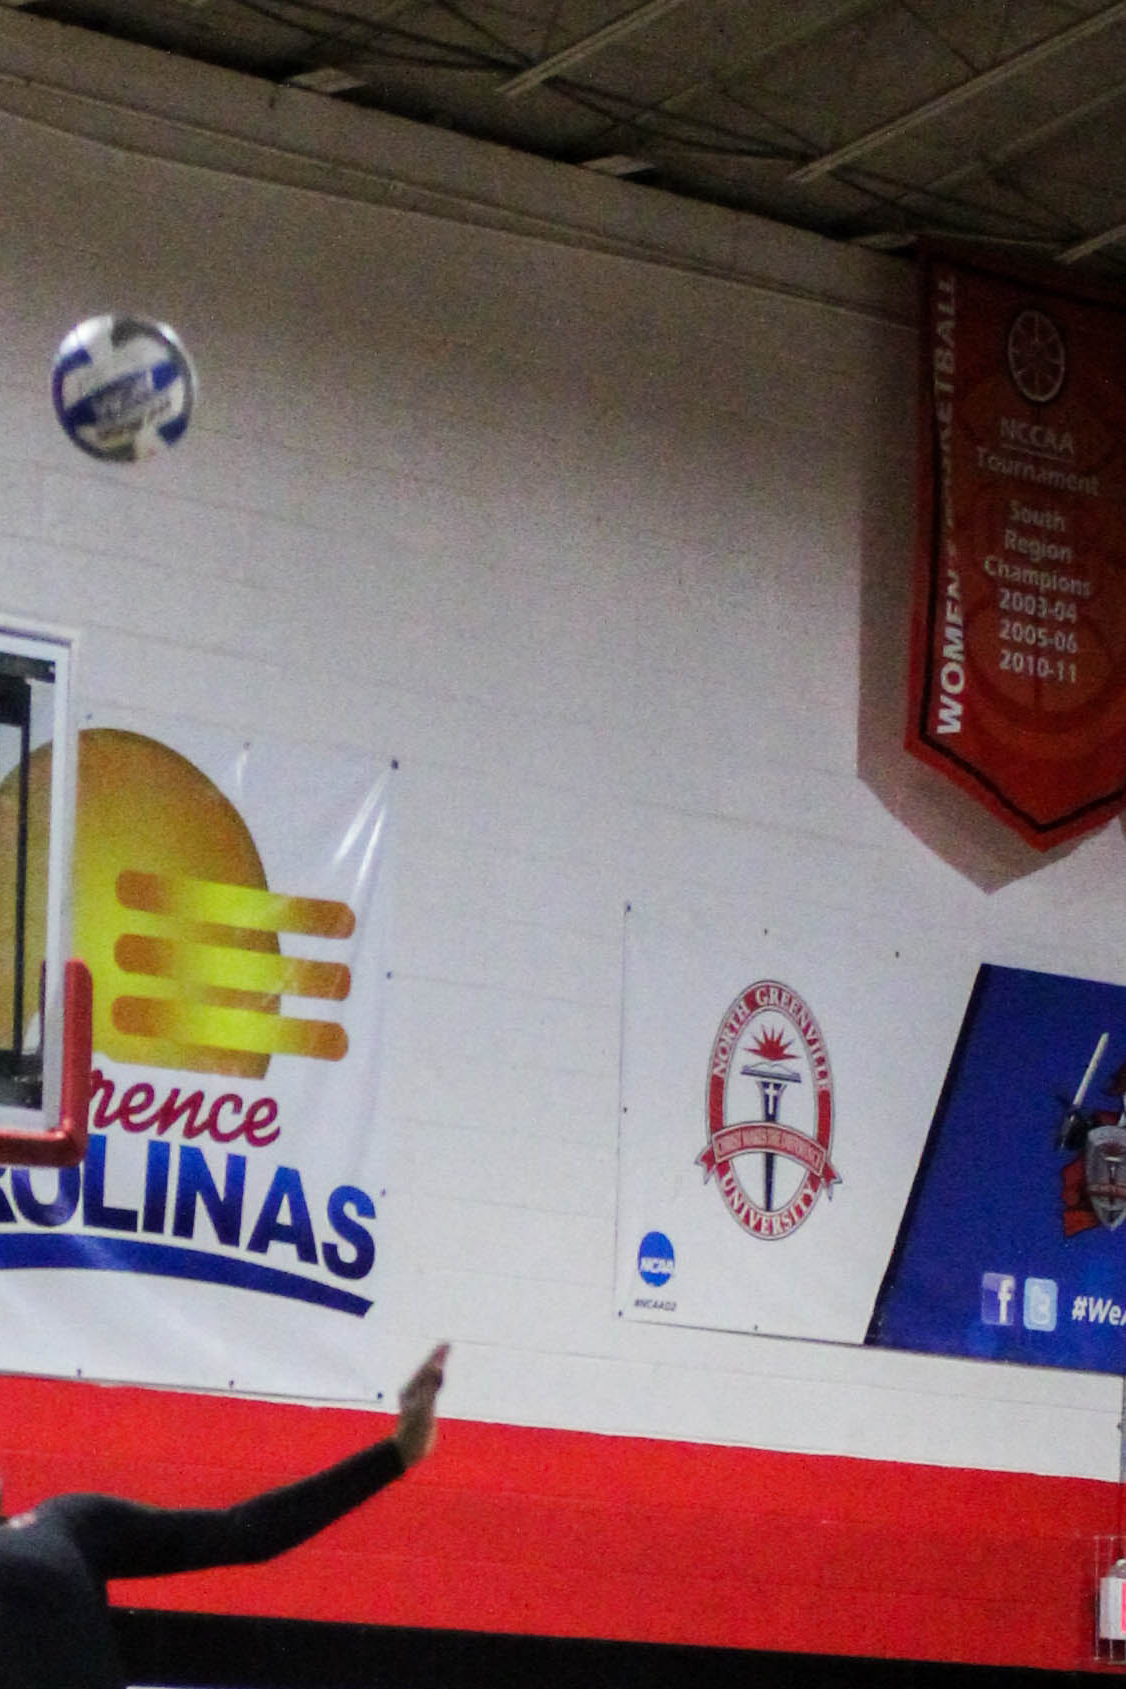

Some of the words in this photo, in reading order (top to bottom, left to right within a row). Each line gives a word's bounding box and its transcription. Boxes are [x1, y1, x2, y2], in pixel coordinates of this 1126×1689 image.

[977, 447, 1100, 496] Tournament
[1010, 501, 1066, 532] South
[1004, 529, 1072, 563] Region
[984, 555, 1091, 597] Champions
[999, 588, 1077, 624] 2003-04
[999, 619, 1078, 654] 2005-06
[999, 649, 1077, 685] 2010-11
[713, 997, 751, 1078] NORTH
[755, 985, 830, 1088] GREENVILLE
[722, 1172, 816, 1235] UNIVERSITY
